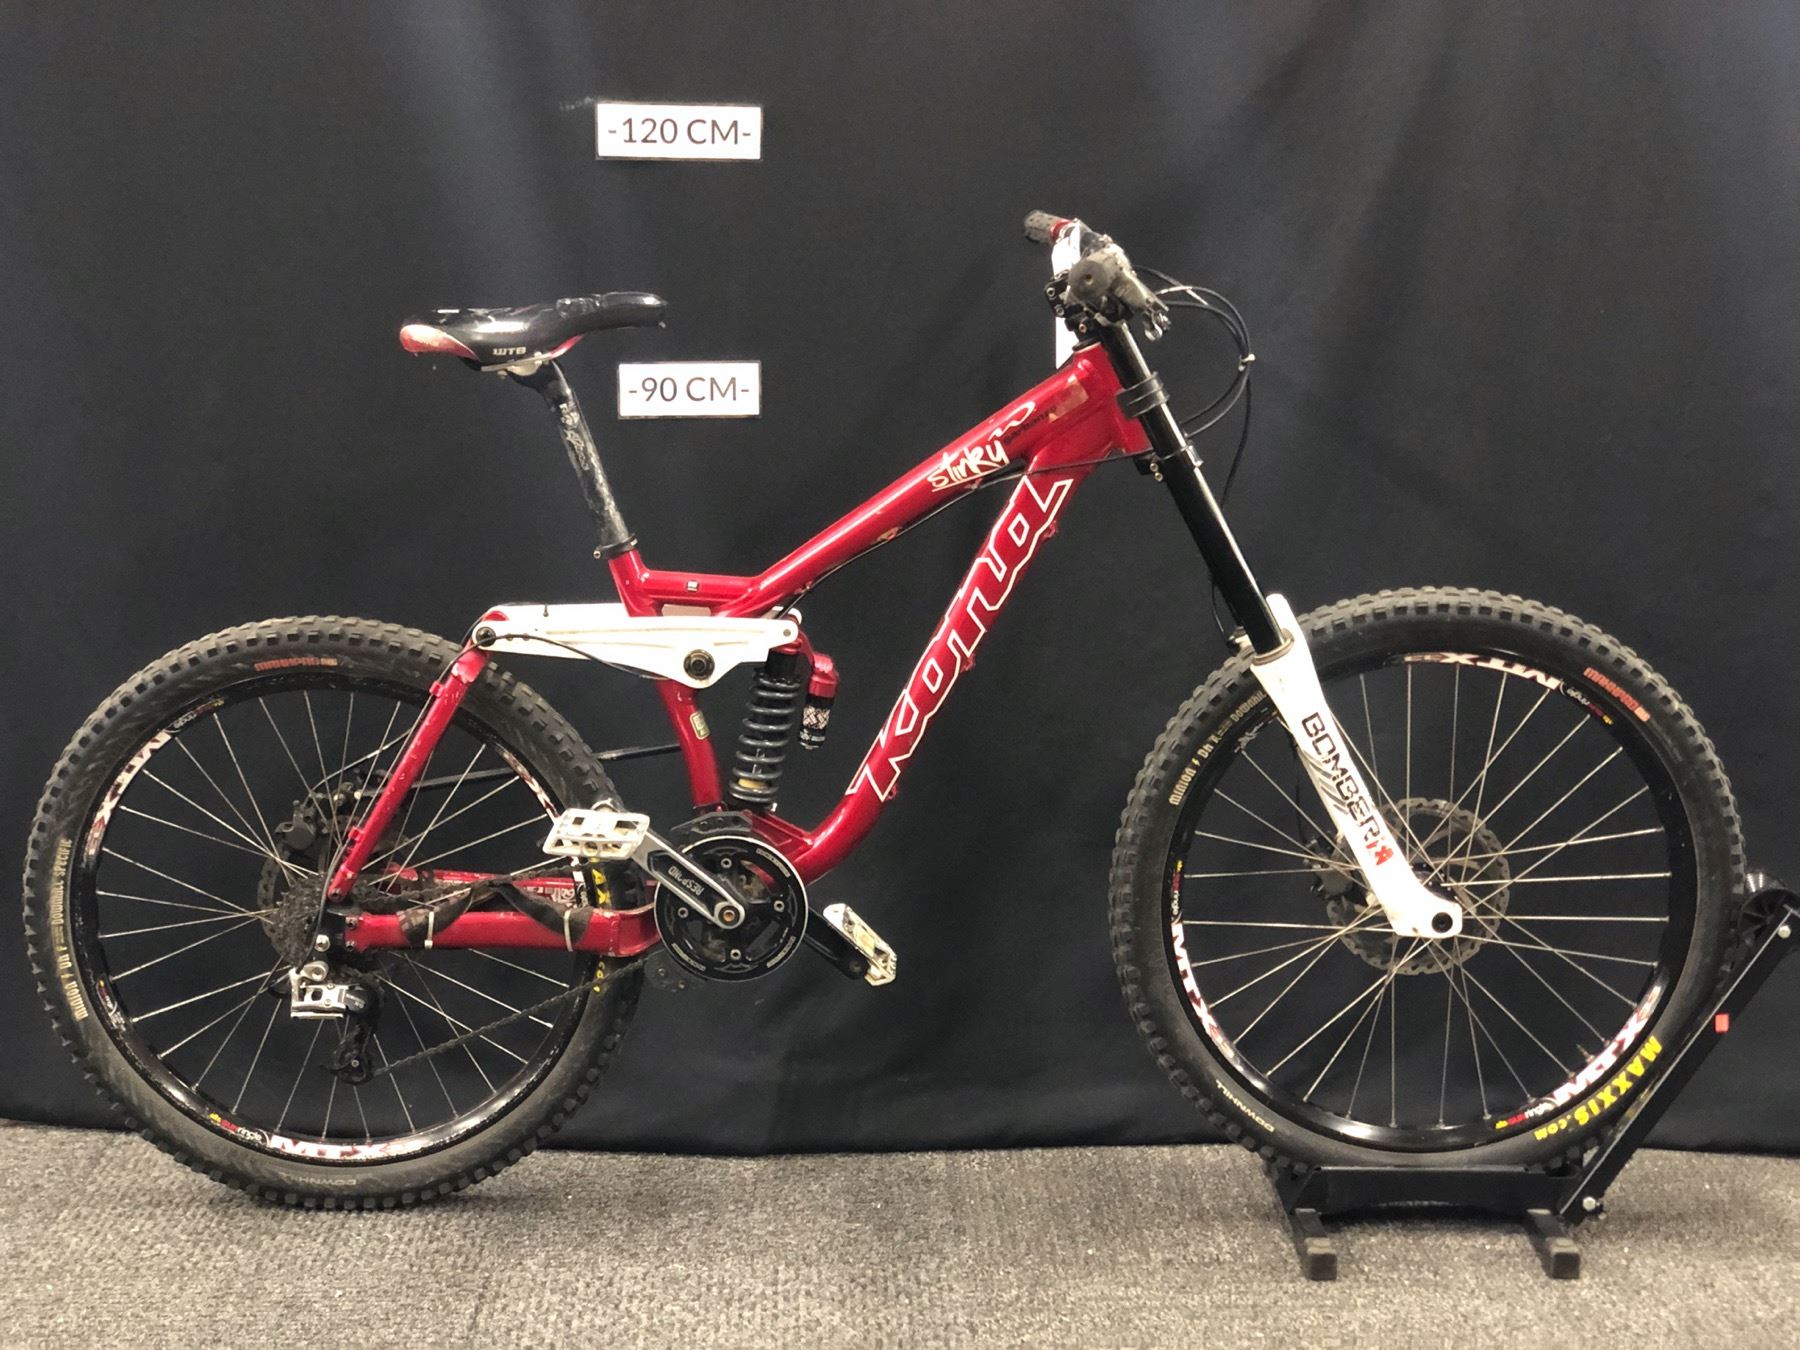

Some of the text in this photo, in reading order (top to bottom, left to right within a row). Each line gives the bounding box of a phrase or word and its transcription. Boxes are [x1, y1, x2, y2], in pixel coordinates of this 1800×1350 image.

[608, 118, 752, 145] -120 CM-
[493, 346, 527, 356] WTB
[628, 376, 749, 402] -90 CM-
[1302, 712, 1380, 845] BOMBER
